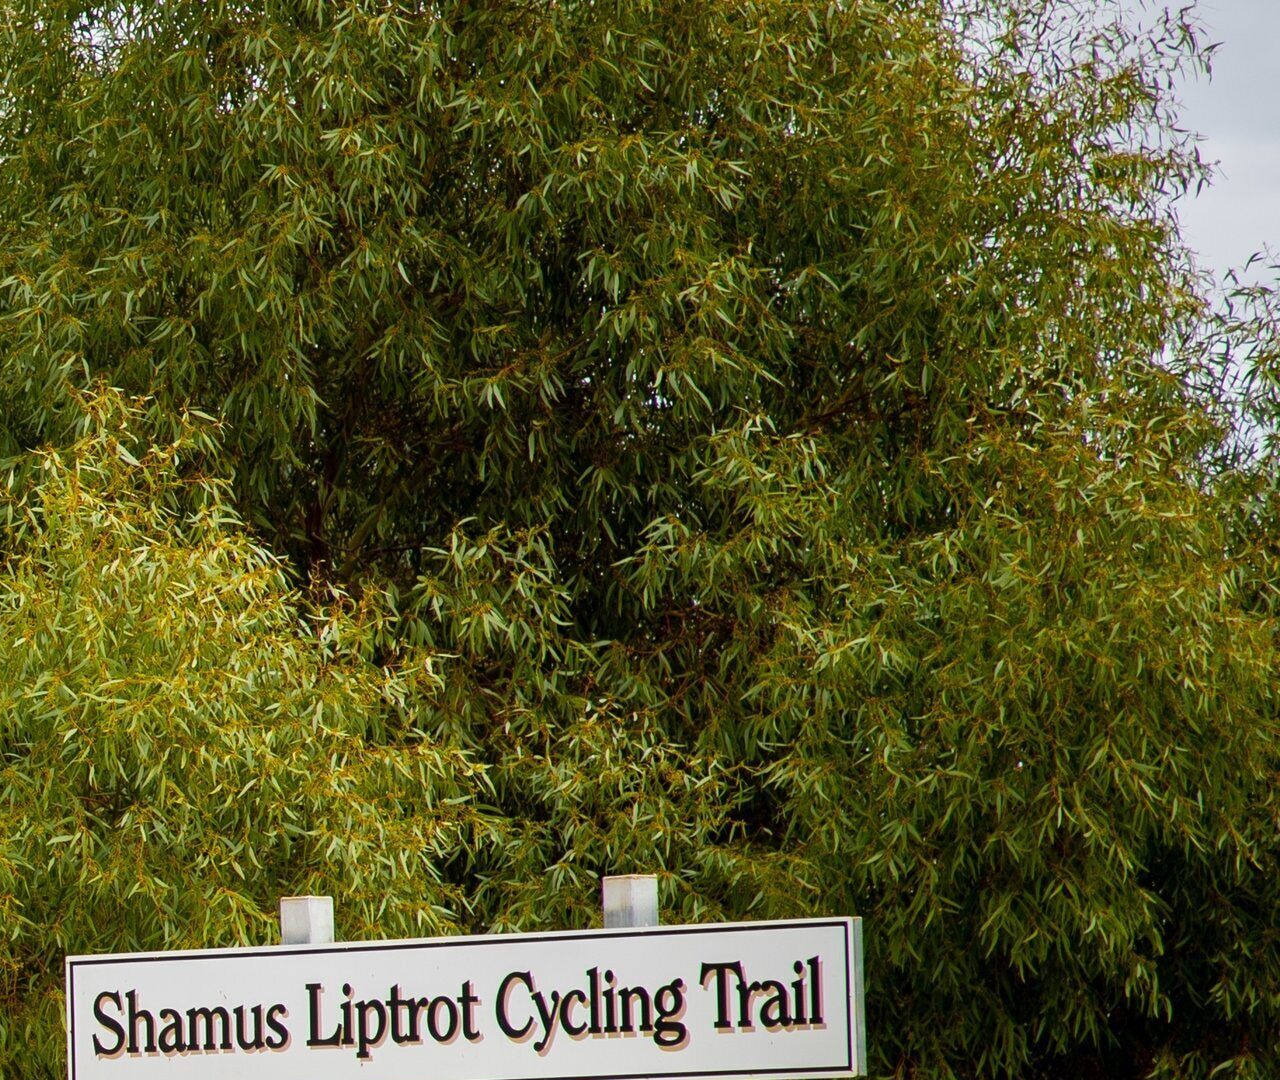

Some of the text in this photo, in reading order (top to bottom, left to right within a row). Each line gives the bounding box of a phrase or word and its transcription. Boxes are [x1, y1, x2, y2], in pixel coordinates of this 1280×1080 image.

[92, 955, 824, 1060] Shamus Liptrot Cycling Trail
